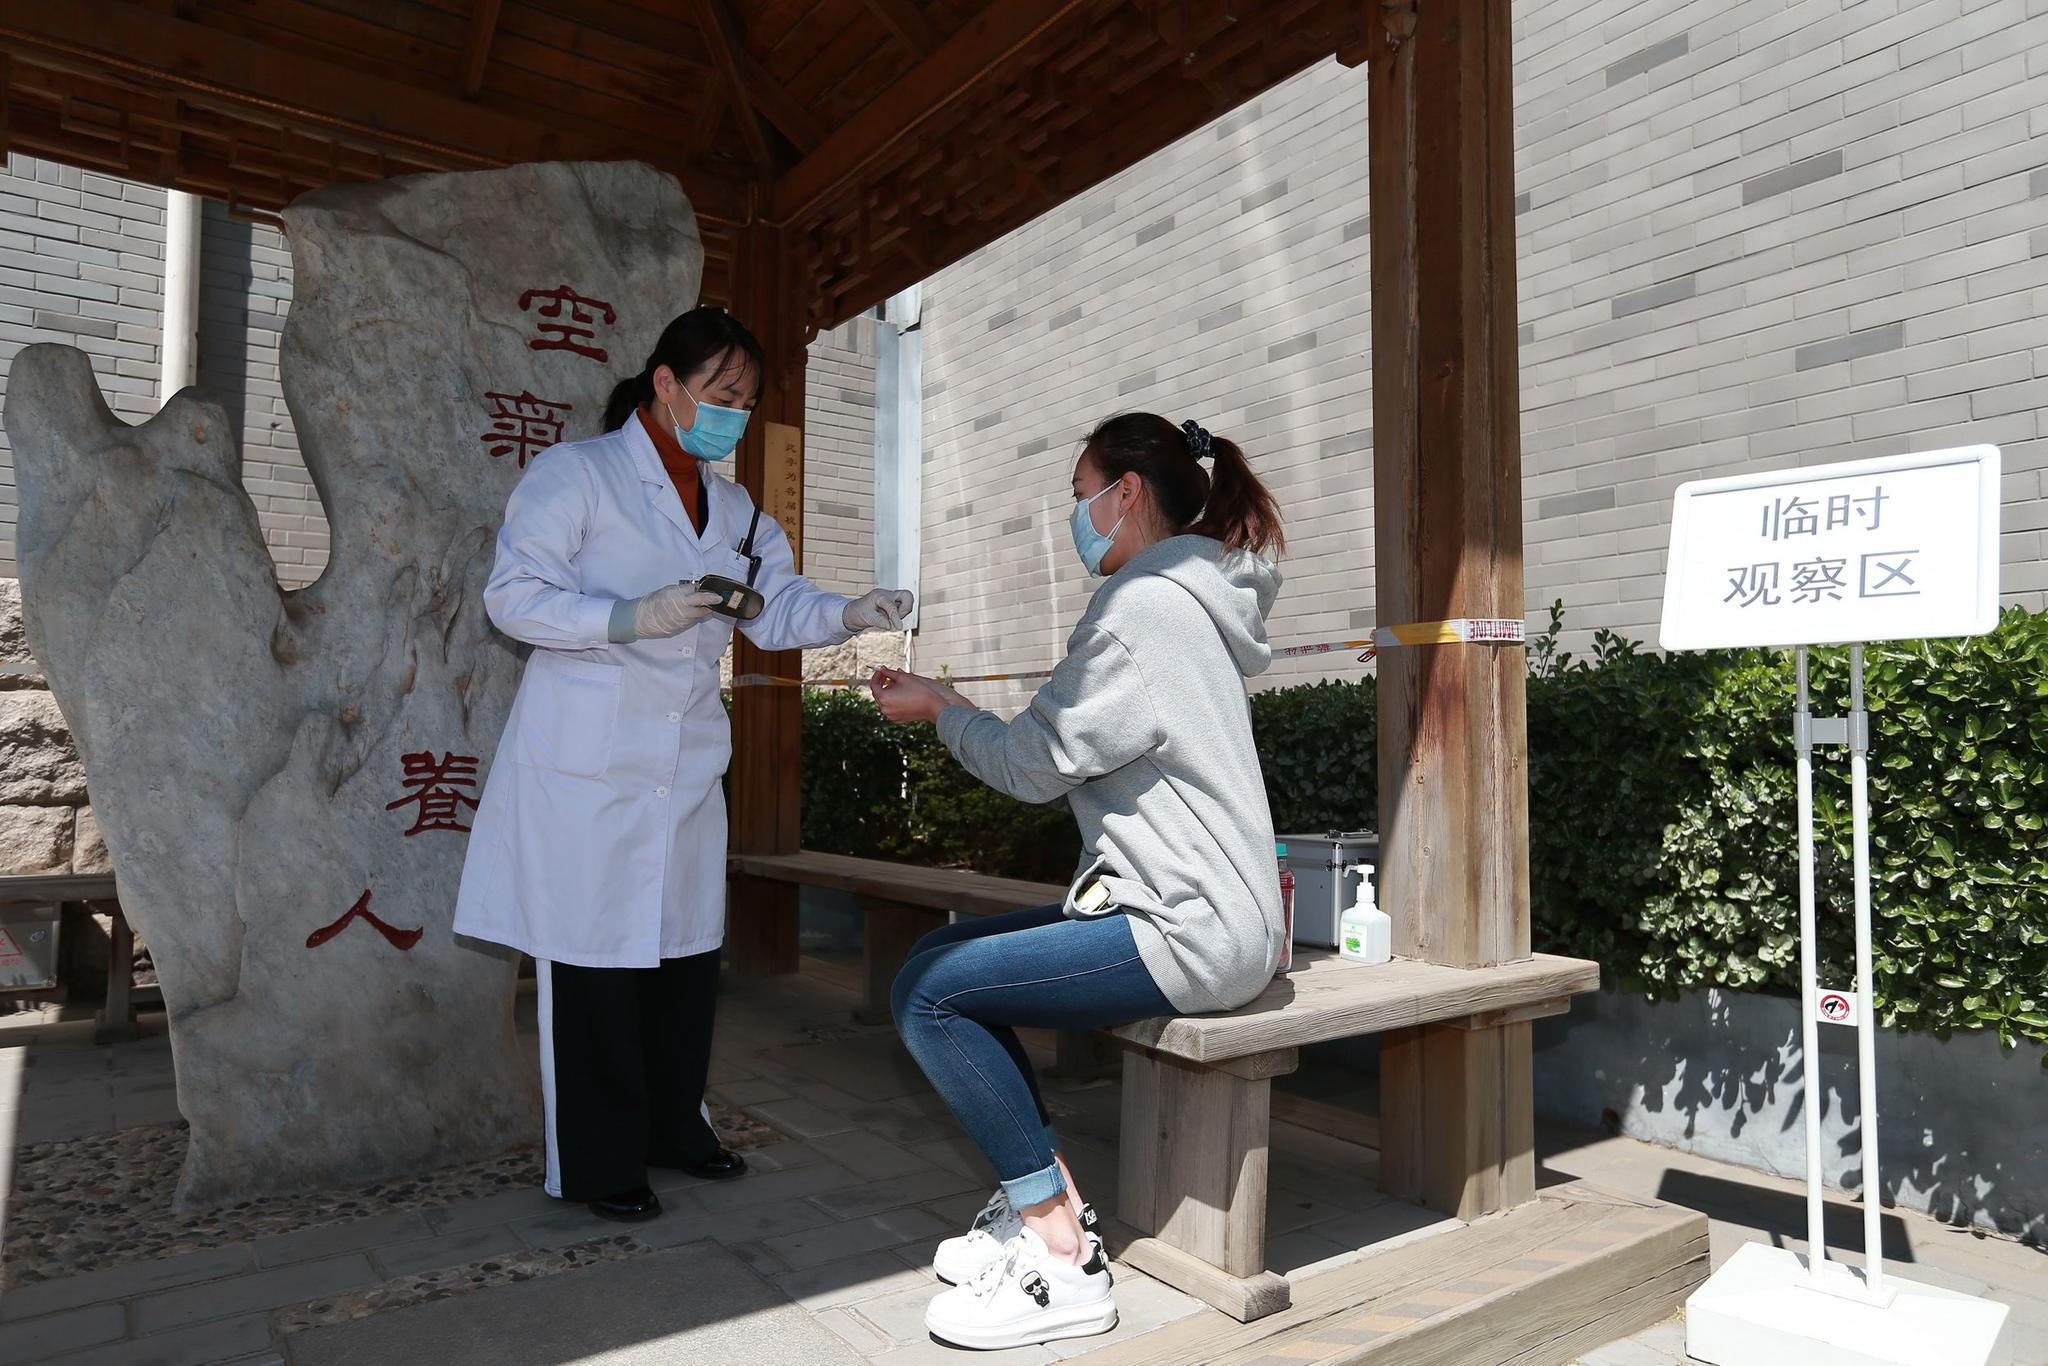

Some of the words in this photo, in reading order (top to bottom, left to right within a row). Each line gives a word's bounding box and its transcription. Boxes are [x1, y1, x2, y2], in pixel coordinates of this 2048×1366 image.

[1761, 485, 1890, 542] 临时
[1722, 549, 1921, 608] 观察区
